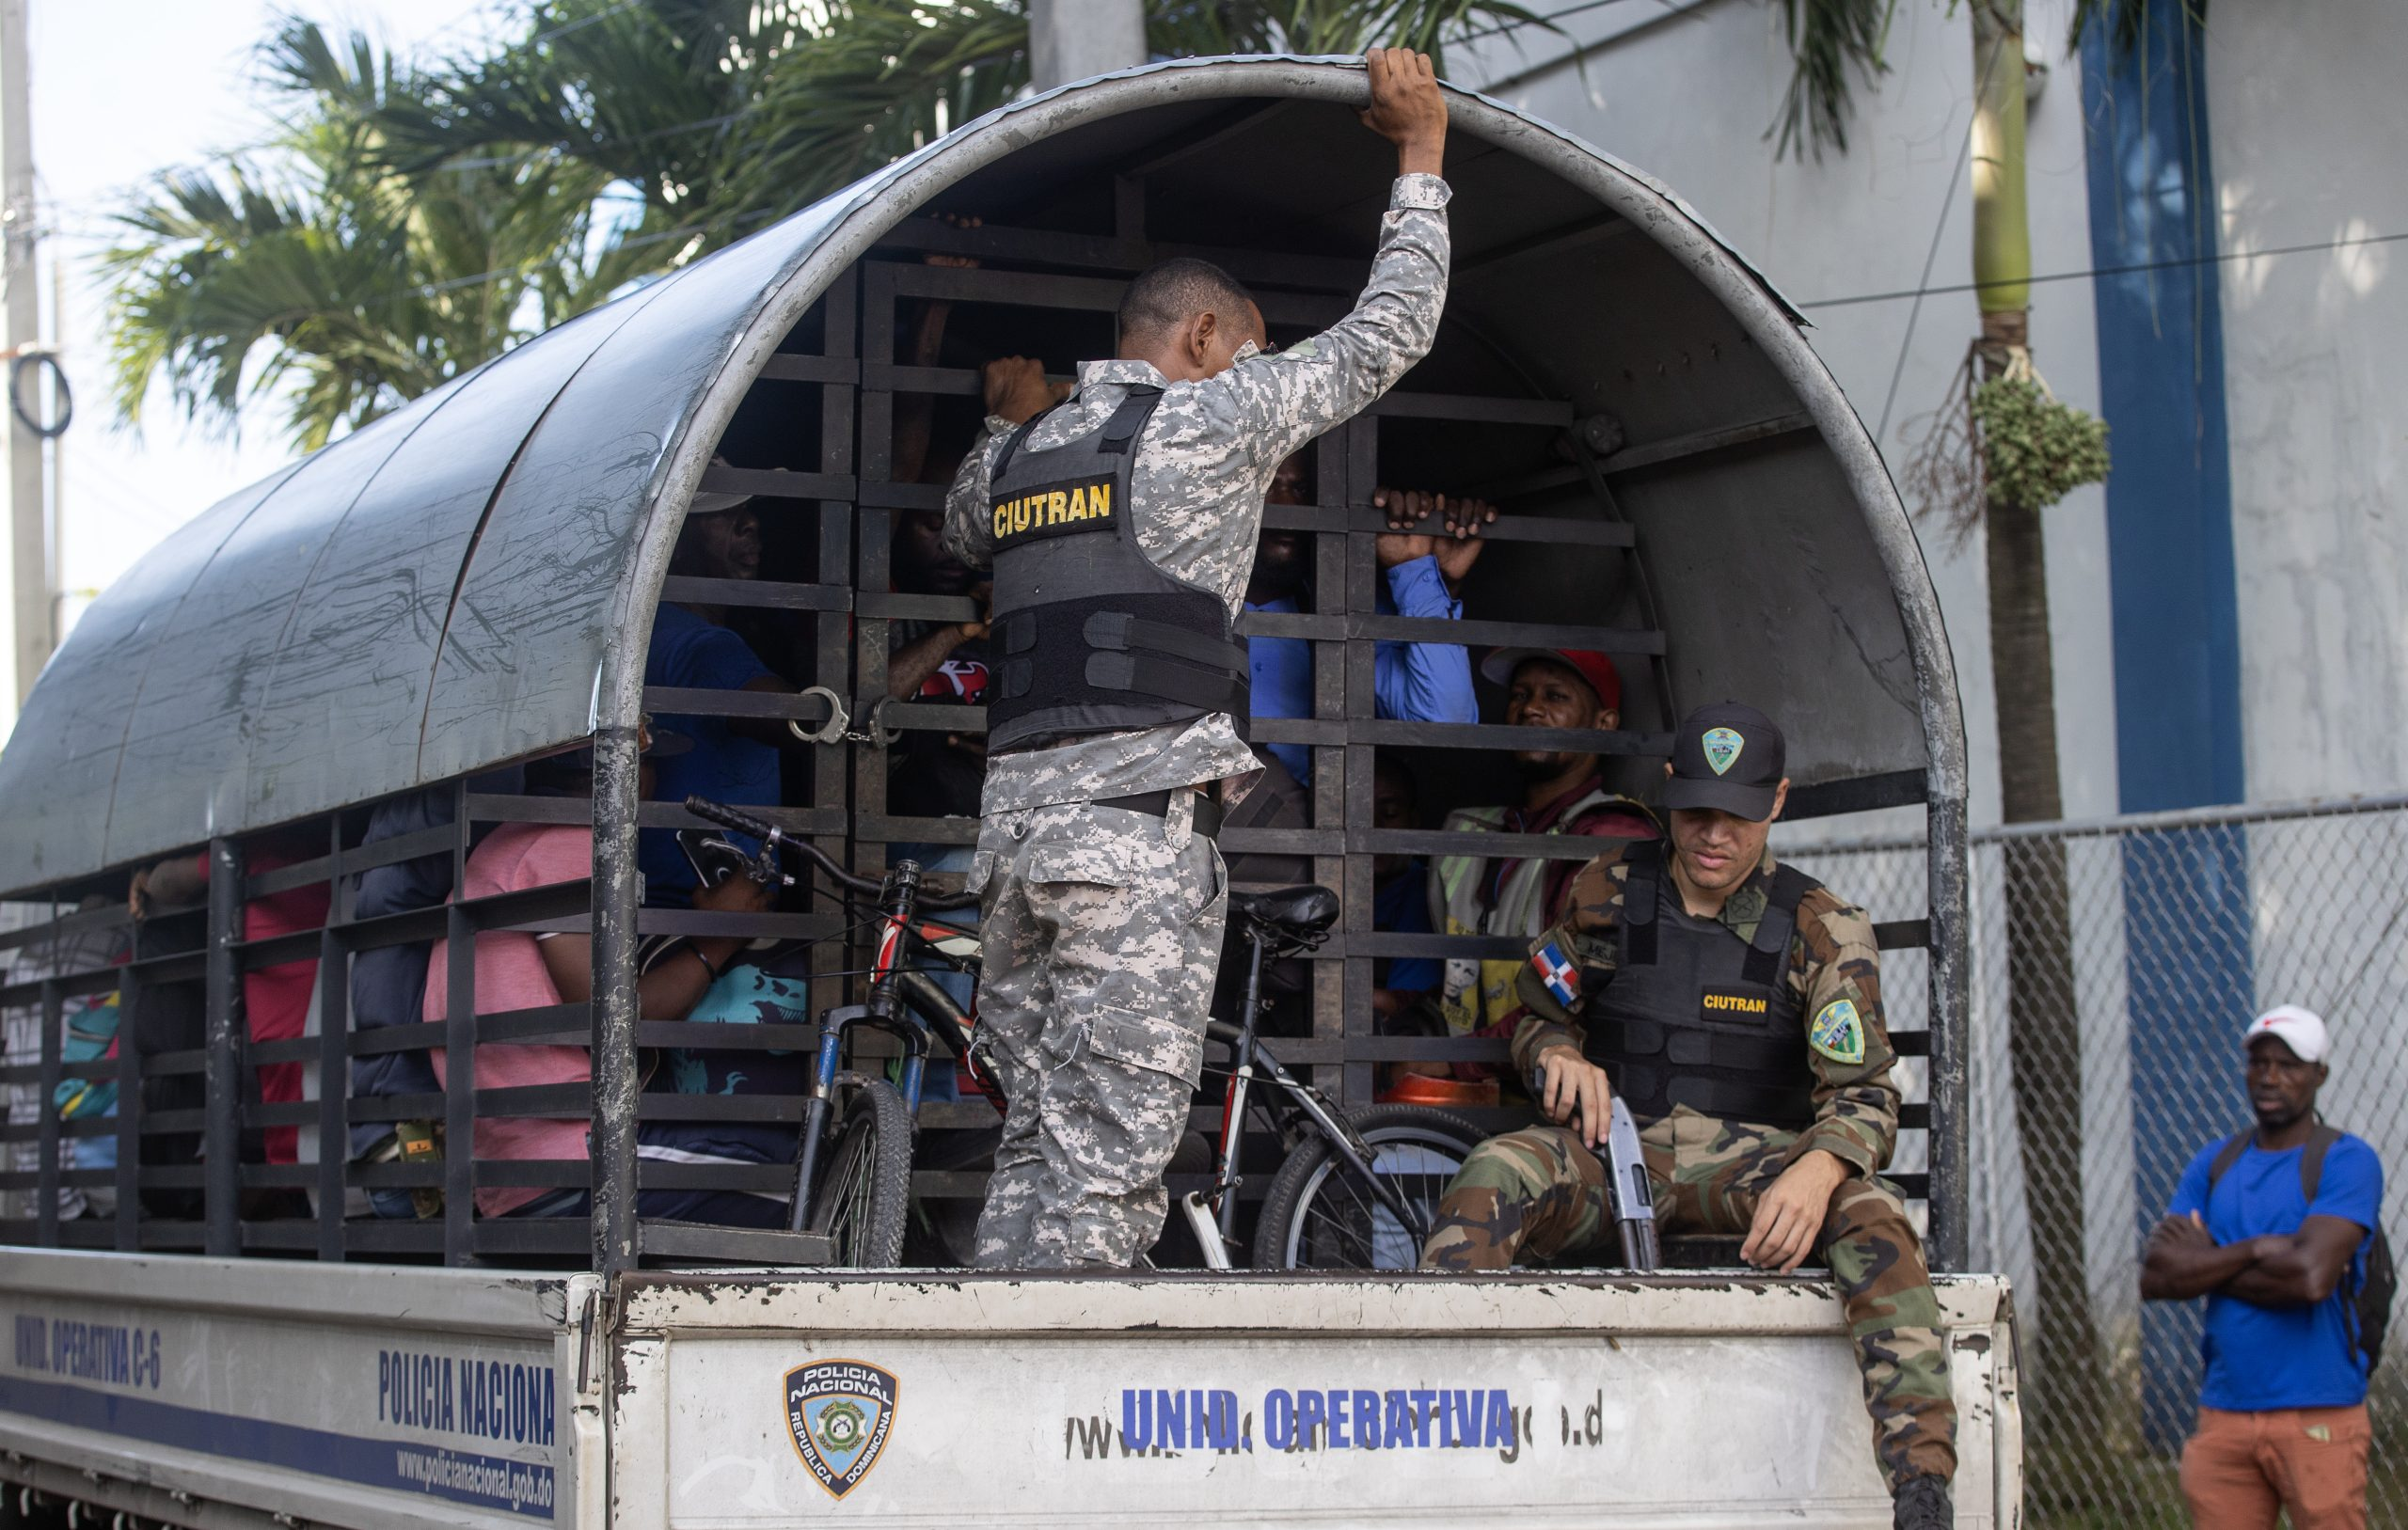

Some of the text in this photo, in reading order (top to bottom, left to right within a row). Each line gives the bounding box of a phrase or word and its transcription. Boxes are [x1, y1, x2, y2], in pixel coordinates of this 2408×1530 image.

[993, 483, 1111, 539] CIUTRAN
[1703, 994, 1766, 1014] CIUTRAN
[52, 1318, 130, 1386] OPERATIVA
[134, 1327, 161, 1390] C-6
[803, 1366, 881, 1386] POLICIA
[379, 1349, 555, 1447] POLICIA NACIONA
[790, 1380, 893, 1406] NACIONAL
[1122, 1389, 1253, 1449] UNID.
[1264, 1388, 1513, 1449] OPERATIVA
[790, 1412, 833, 1486] REPUBLICA
[846, 1411, 892, 1485] DOMINICANA
[397, 1449, 553, 1511] www.policianacional.gob.do
